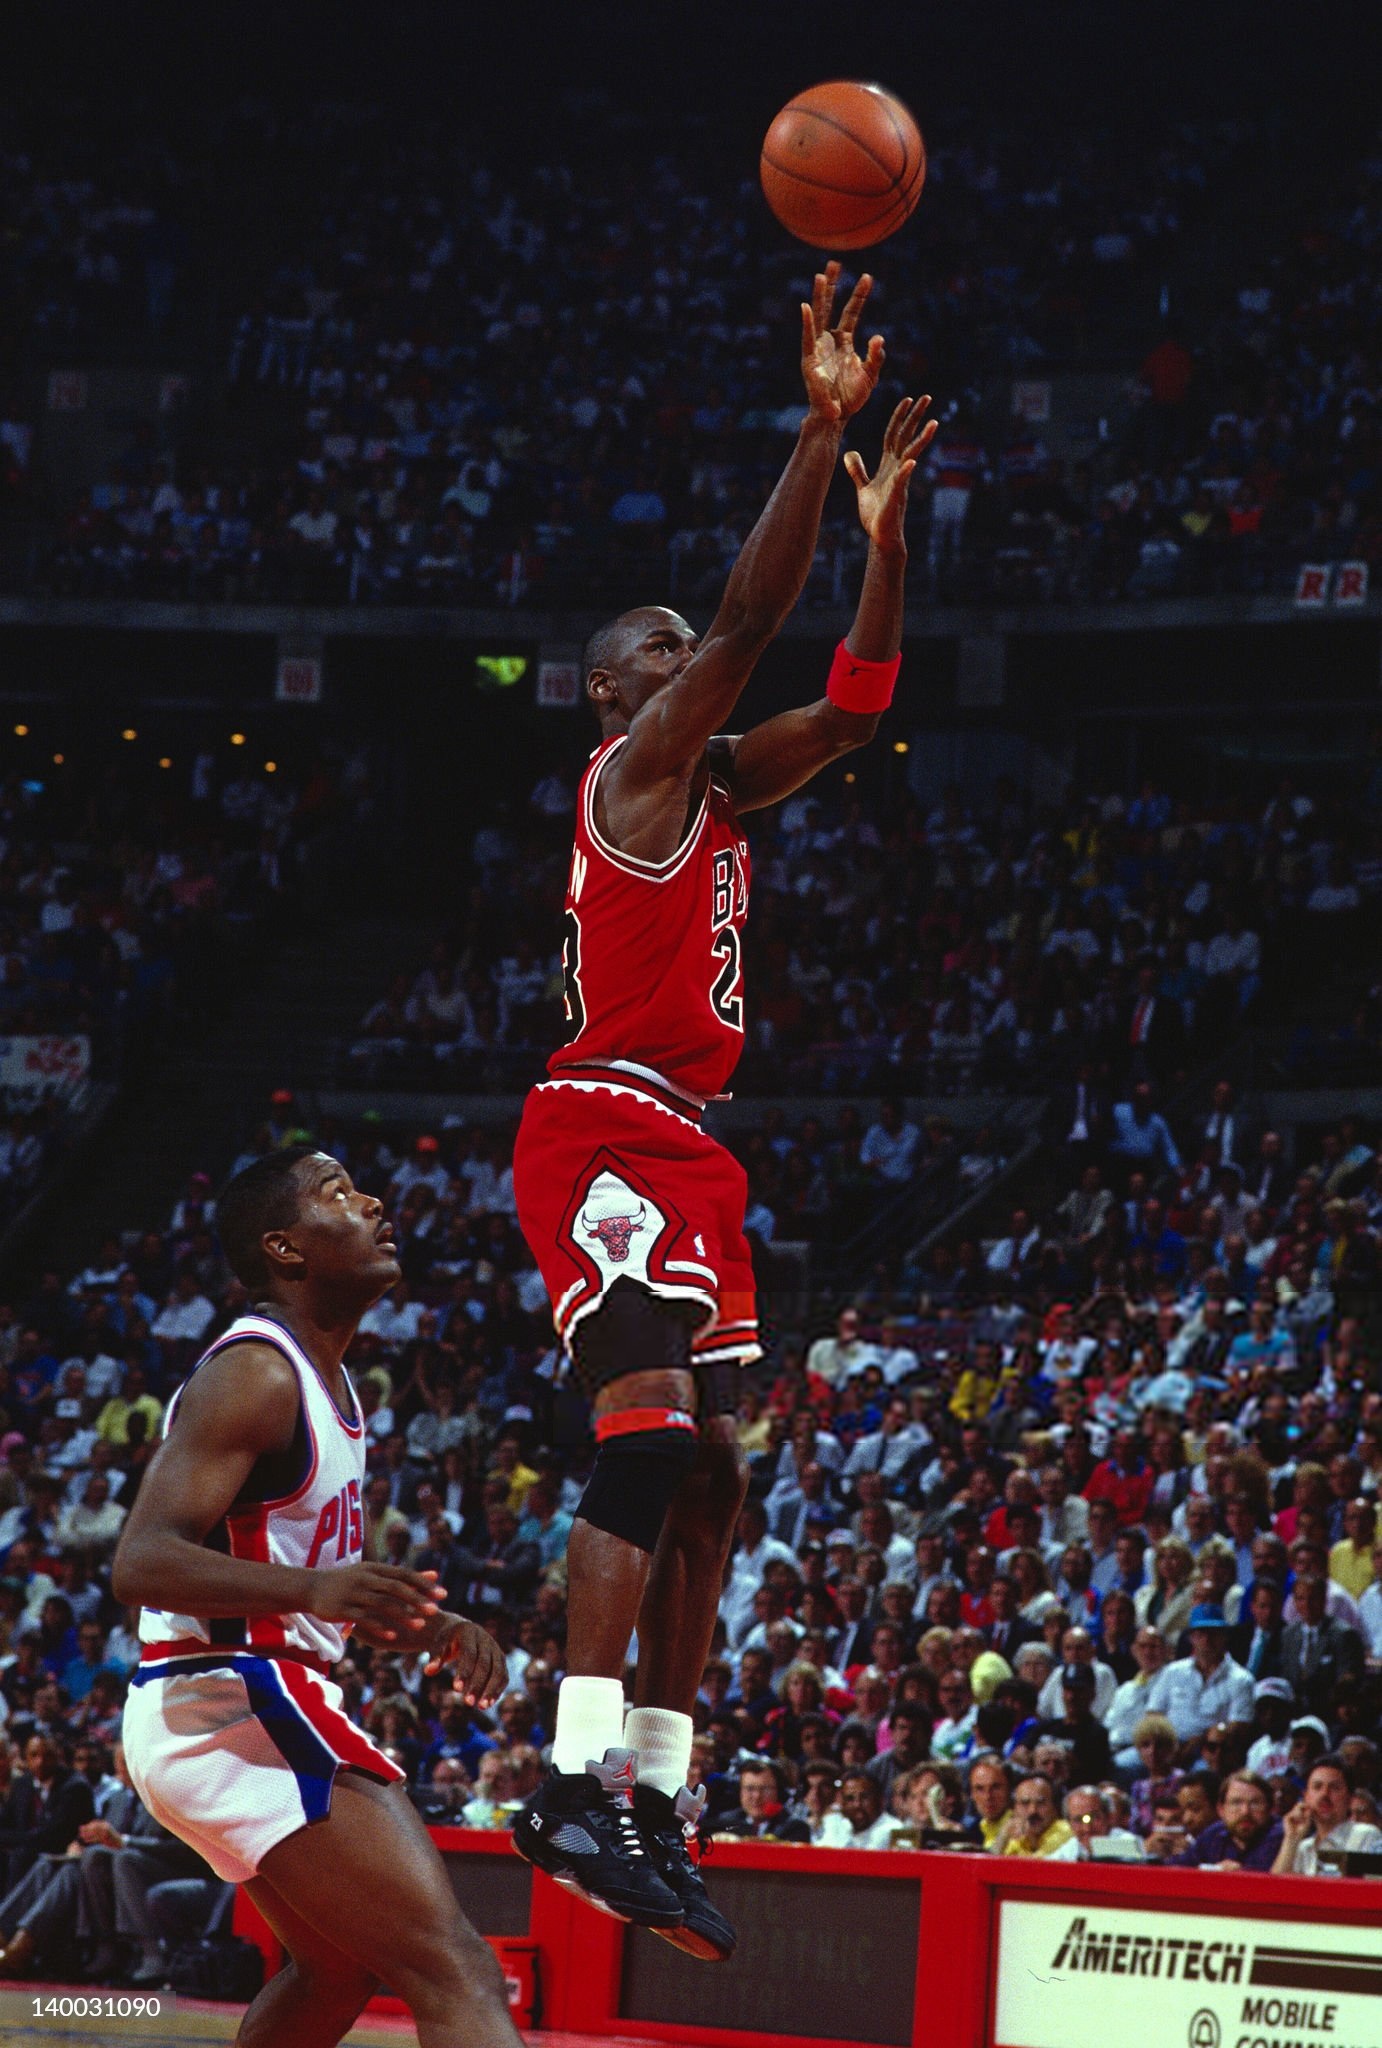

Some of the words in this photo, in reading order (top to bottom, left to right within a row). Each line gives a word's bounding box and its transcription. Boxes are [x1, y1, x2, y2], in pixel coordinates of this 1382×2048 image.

[567, 842, 588, 904] N
[709, 924, 744, 1033] 2
[305, 1478, 363, 1568] PIS
[530, 1812, 543, 1832] 23
[1050, 1917, 1247, 1985] AMERITECH
[1240, 1997, 1339, 2031] MOBILE
